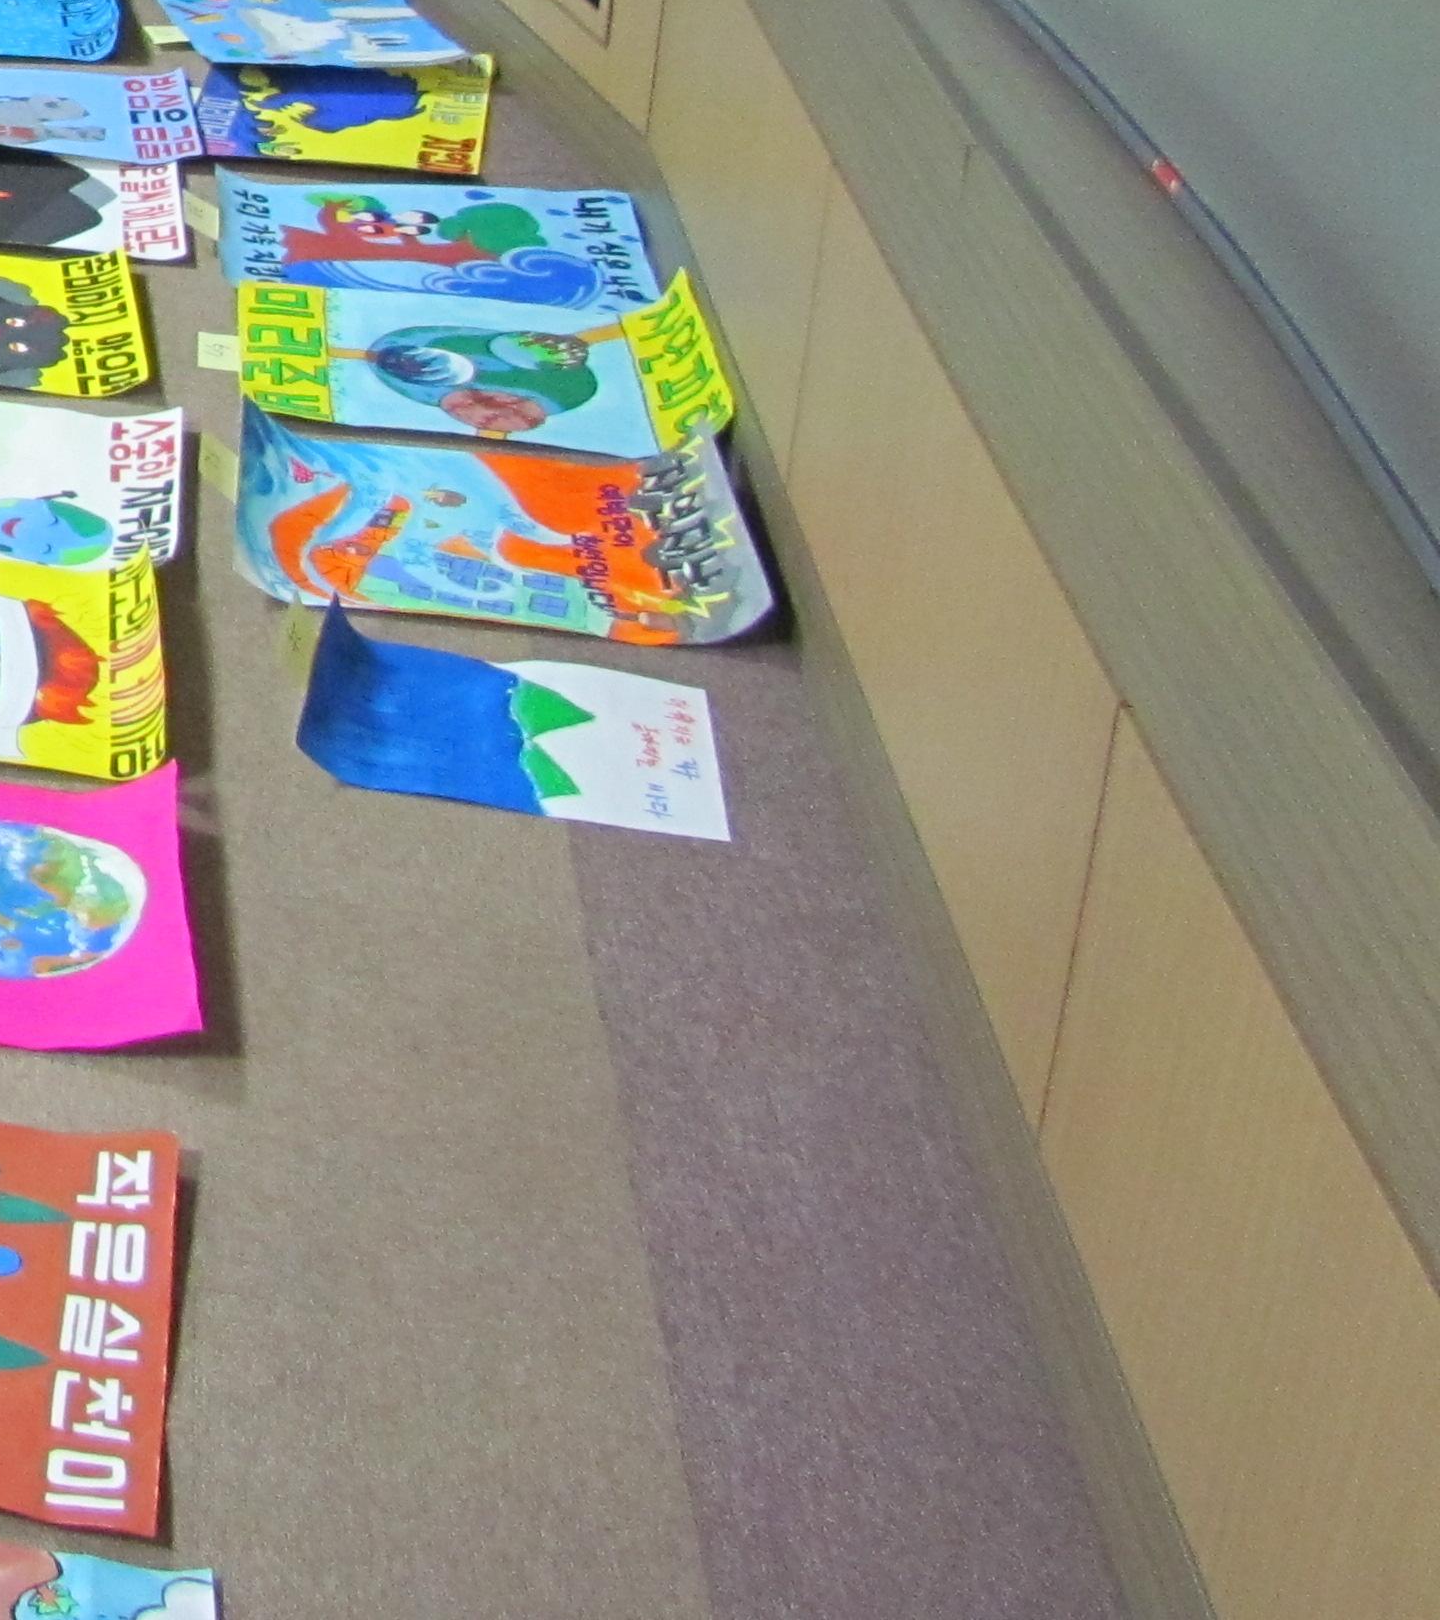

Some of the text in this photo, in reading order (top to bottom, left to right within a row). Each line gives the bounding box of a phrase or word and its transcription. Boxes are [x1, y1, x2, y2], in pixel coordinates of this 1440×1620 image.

[232, 189, 270, 218] 우리
[61, 250, 140, 397] 준비하지 않으면
[108, 418, 175, 482] 소중한
[43, 1147, 153, 1513] 작은 실천이
